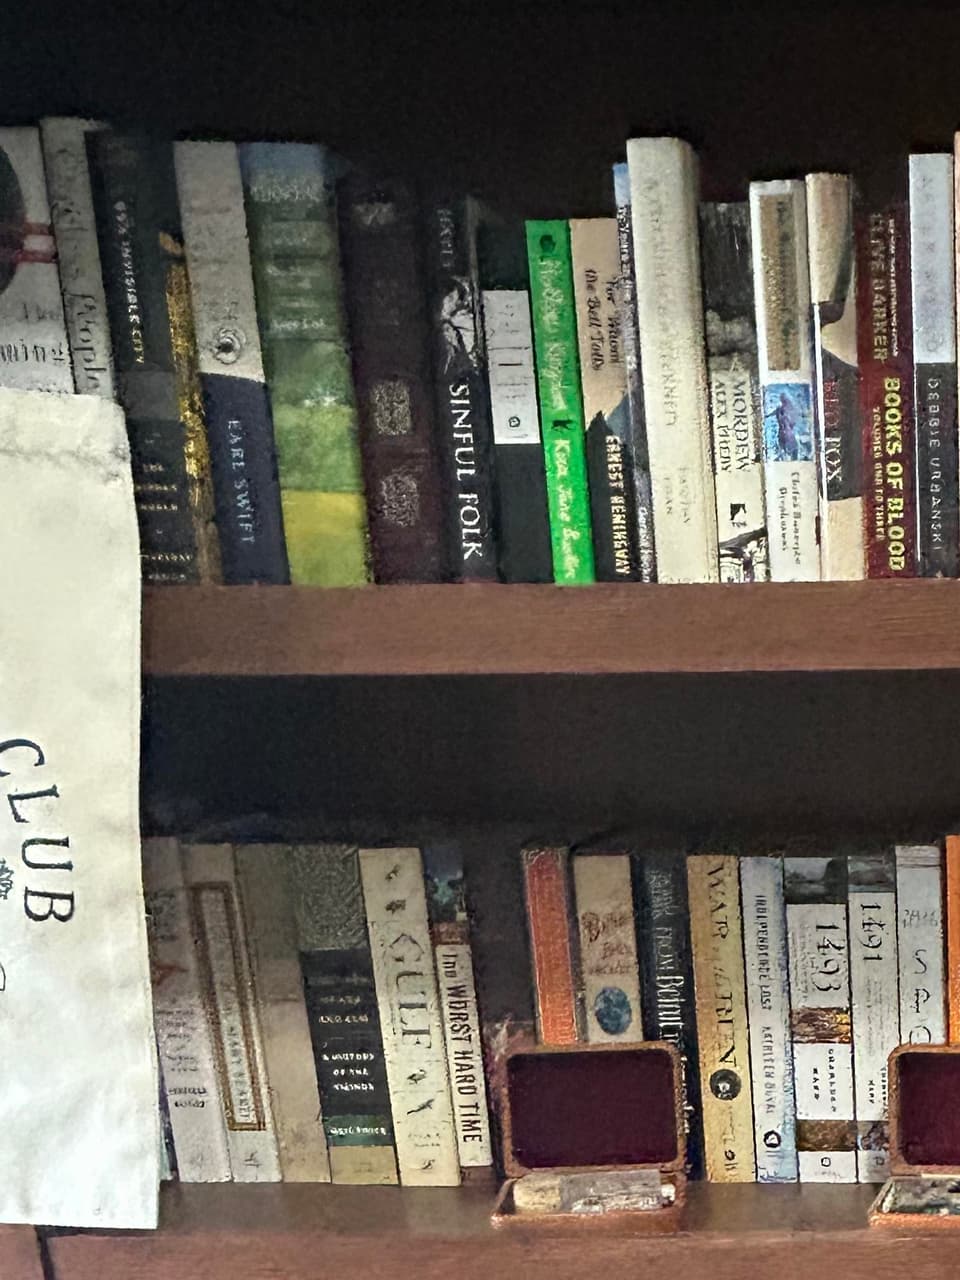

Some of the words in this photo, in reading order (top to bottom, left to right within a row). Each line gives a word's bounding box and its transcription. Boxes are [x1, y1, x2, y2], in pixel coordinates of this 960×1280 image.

[119, 241, 141, 324] INVISIBLE
[584, 268, 602, 291] the
[586, 297, 604, 329] Bell
[128, 326, 146, 364] CITY
[871, 278, 889, 361] BARKER
[227, 420, 246, 470] EARL
[449, 383, 479, 481] SINFUL
[731, 381, 751, 473] MORDEW
[884, 377, 903, 454] BOOKS
[926, 378, 942, 449] DEBBIE
[605, 436, 626, 489] ERNEST
[886, 461, 904, 490] OF
[233, 480, 256, 544] SWIFT
[457, 493, 484, 561] FOLK
[610, 496, 632, 577] HEMINGWAY
[886, 497, 905, 572] BLOOD
[929, 457, 945, 551] URBANSKI
[0, 738, 75, 922] CLUB
[706, 862, 732, 939] WAR
[859, 902, 884, 962] 1491
[815, 921, 847, 993] 1493
[390, 933, 432, 1050] GULF
[448, 984, 475, 1043] WORST
[655, 975, 686, 1027] Beirut
[757, 984, 774, 1011] LOST
[454, 1050, 479, 1096] HARD
[460, 1102, 484, 1143] TIME
